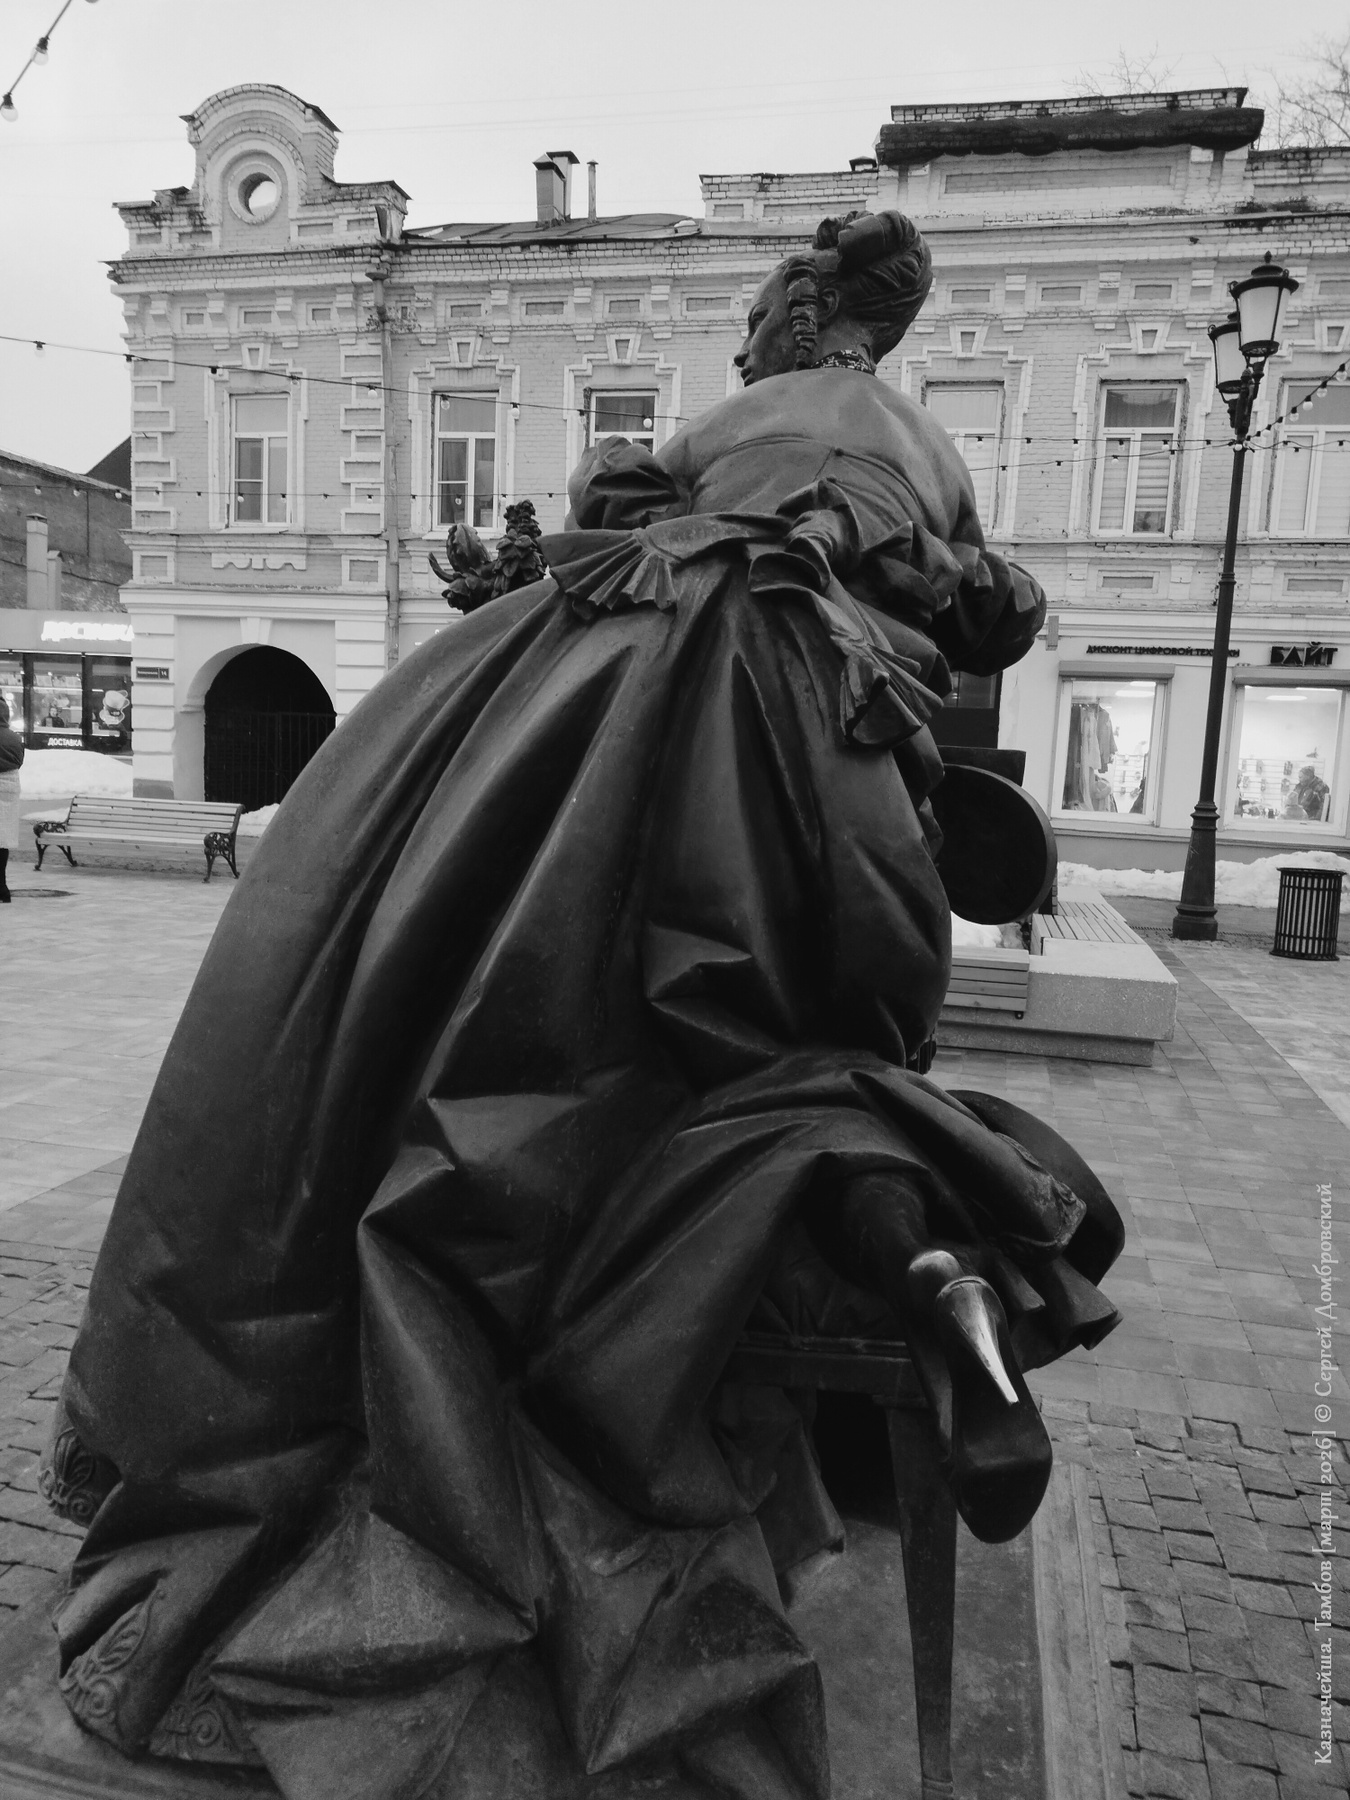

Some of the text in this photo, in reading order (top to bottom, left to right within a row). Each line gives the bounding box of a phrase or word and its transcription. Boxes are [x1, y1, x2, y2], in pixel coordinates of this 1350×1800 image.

[1086, 645, 1240, 658] ДИСКОНТ ЦИФРОВОЙ ТЕХКИ
[1270, 641, 1338, 667] БАЙТ
[48, 737, 83, 747] ДОСТАВКА
